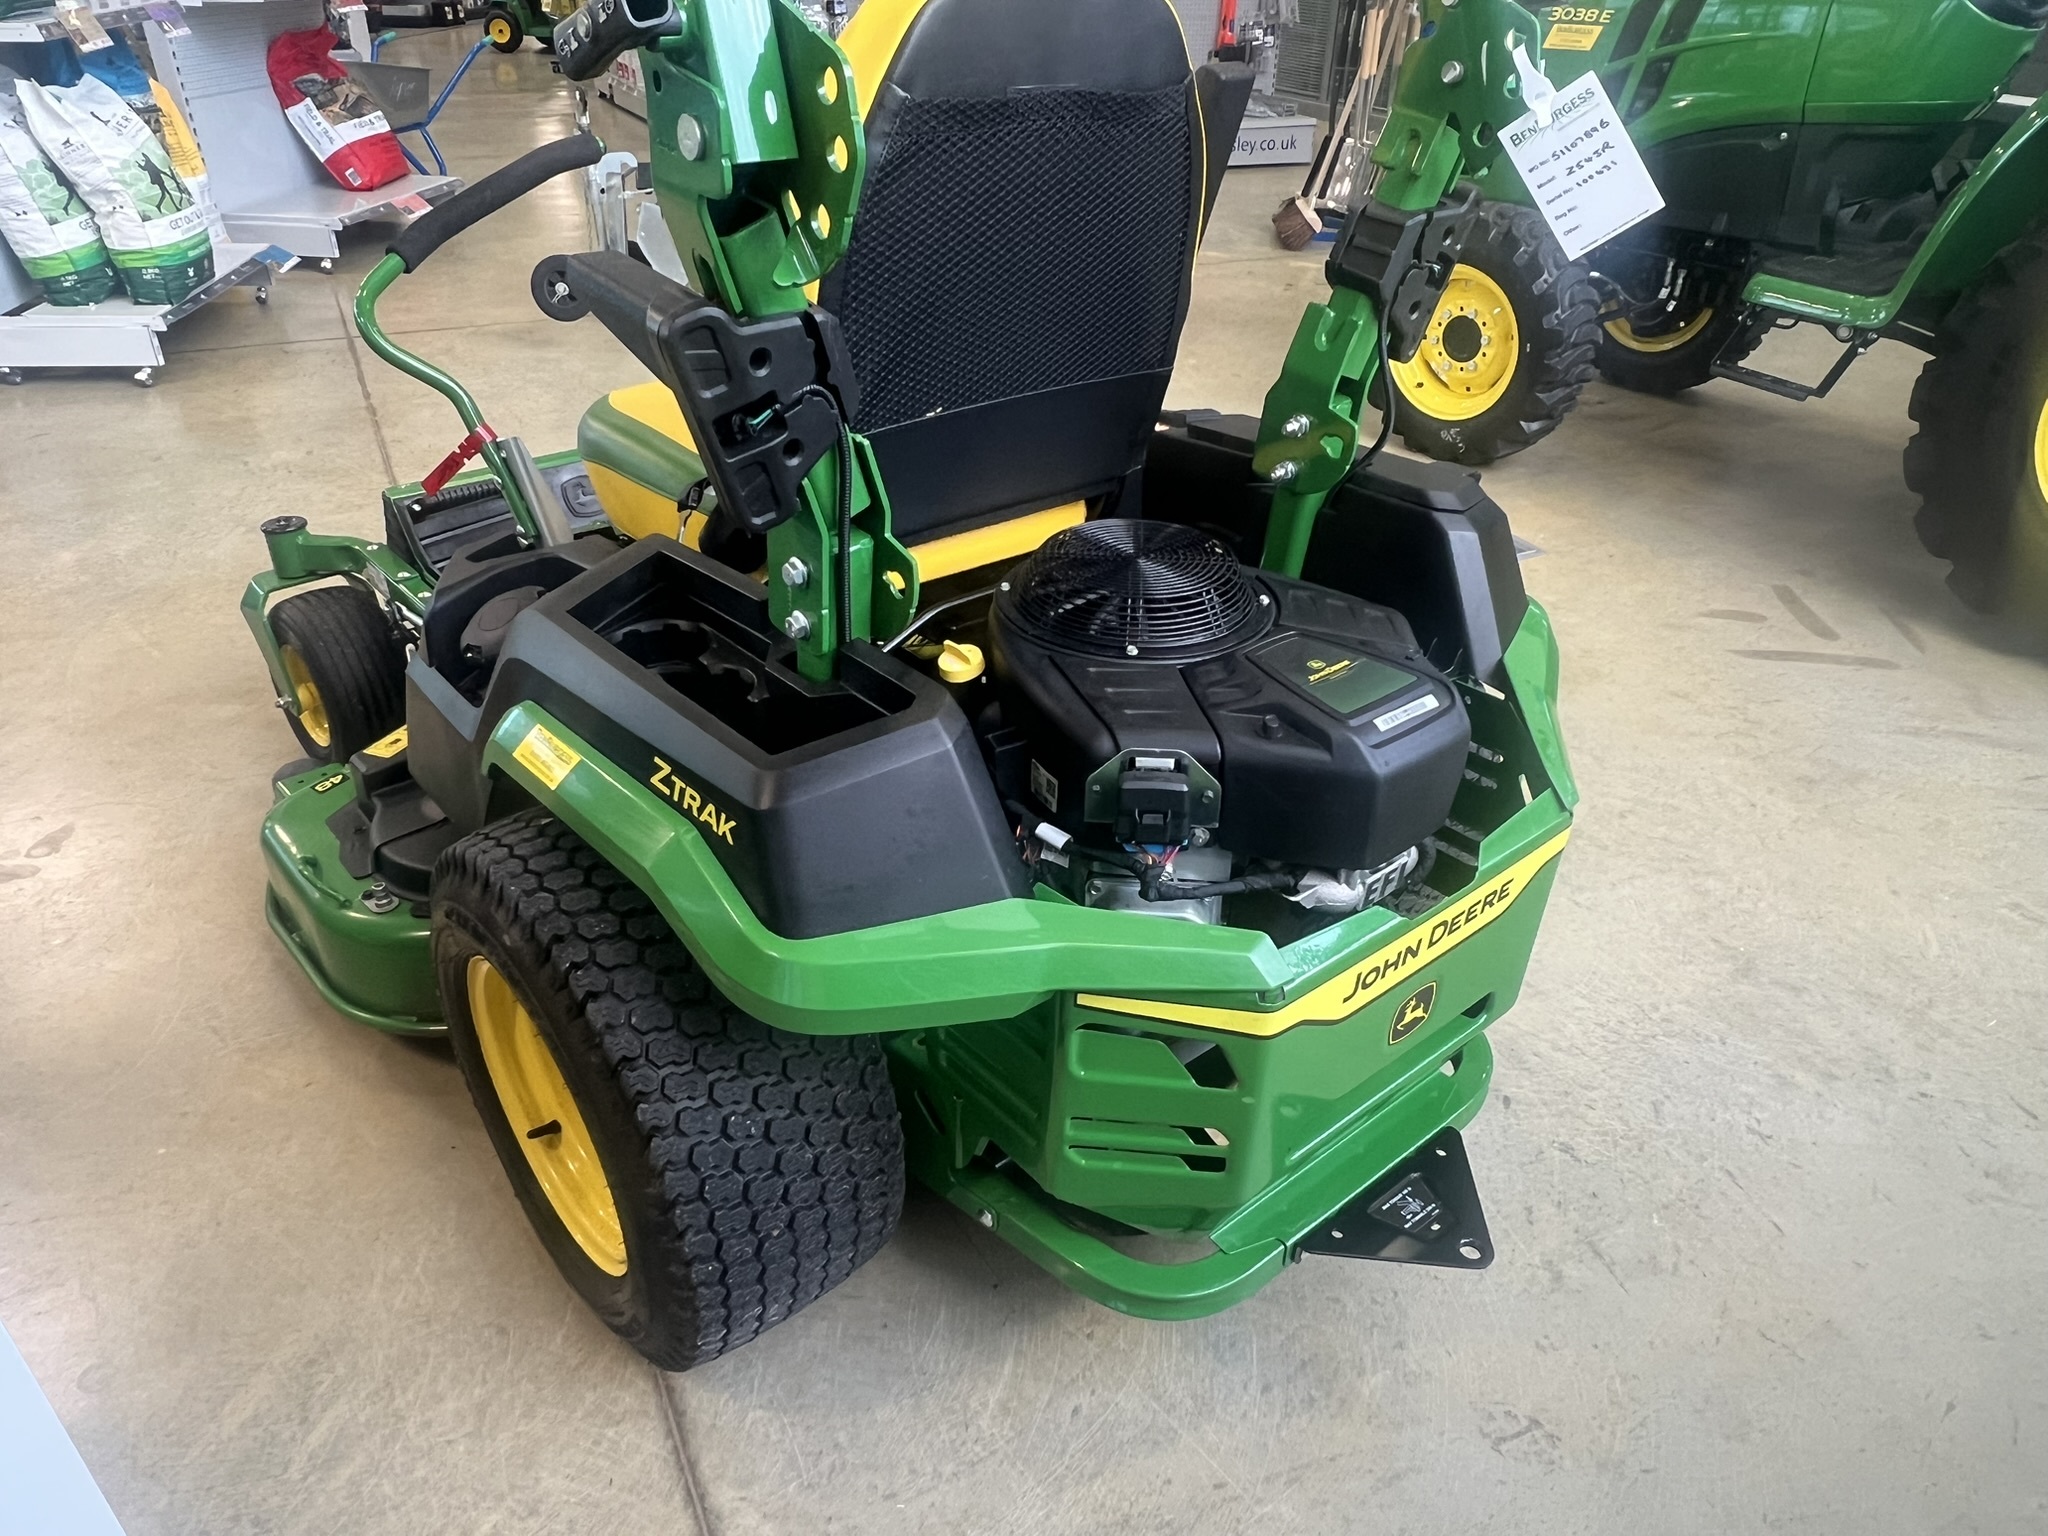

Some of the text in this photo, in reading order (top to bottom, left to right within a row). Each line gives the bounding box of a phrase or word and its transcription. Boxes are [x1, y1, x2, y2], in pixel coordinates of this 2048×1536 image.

[1547, 6, 1615, 23] 3038E
[1509, 87, 1595, 147] BENRGESS
[650, 756, 738, 846] ZTRAK
[1342, 878, 1515, 1004] JOHN DEERE
